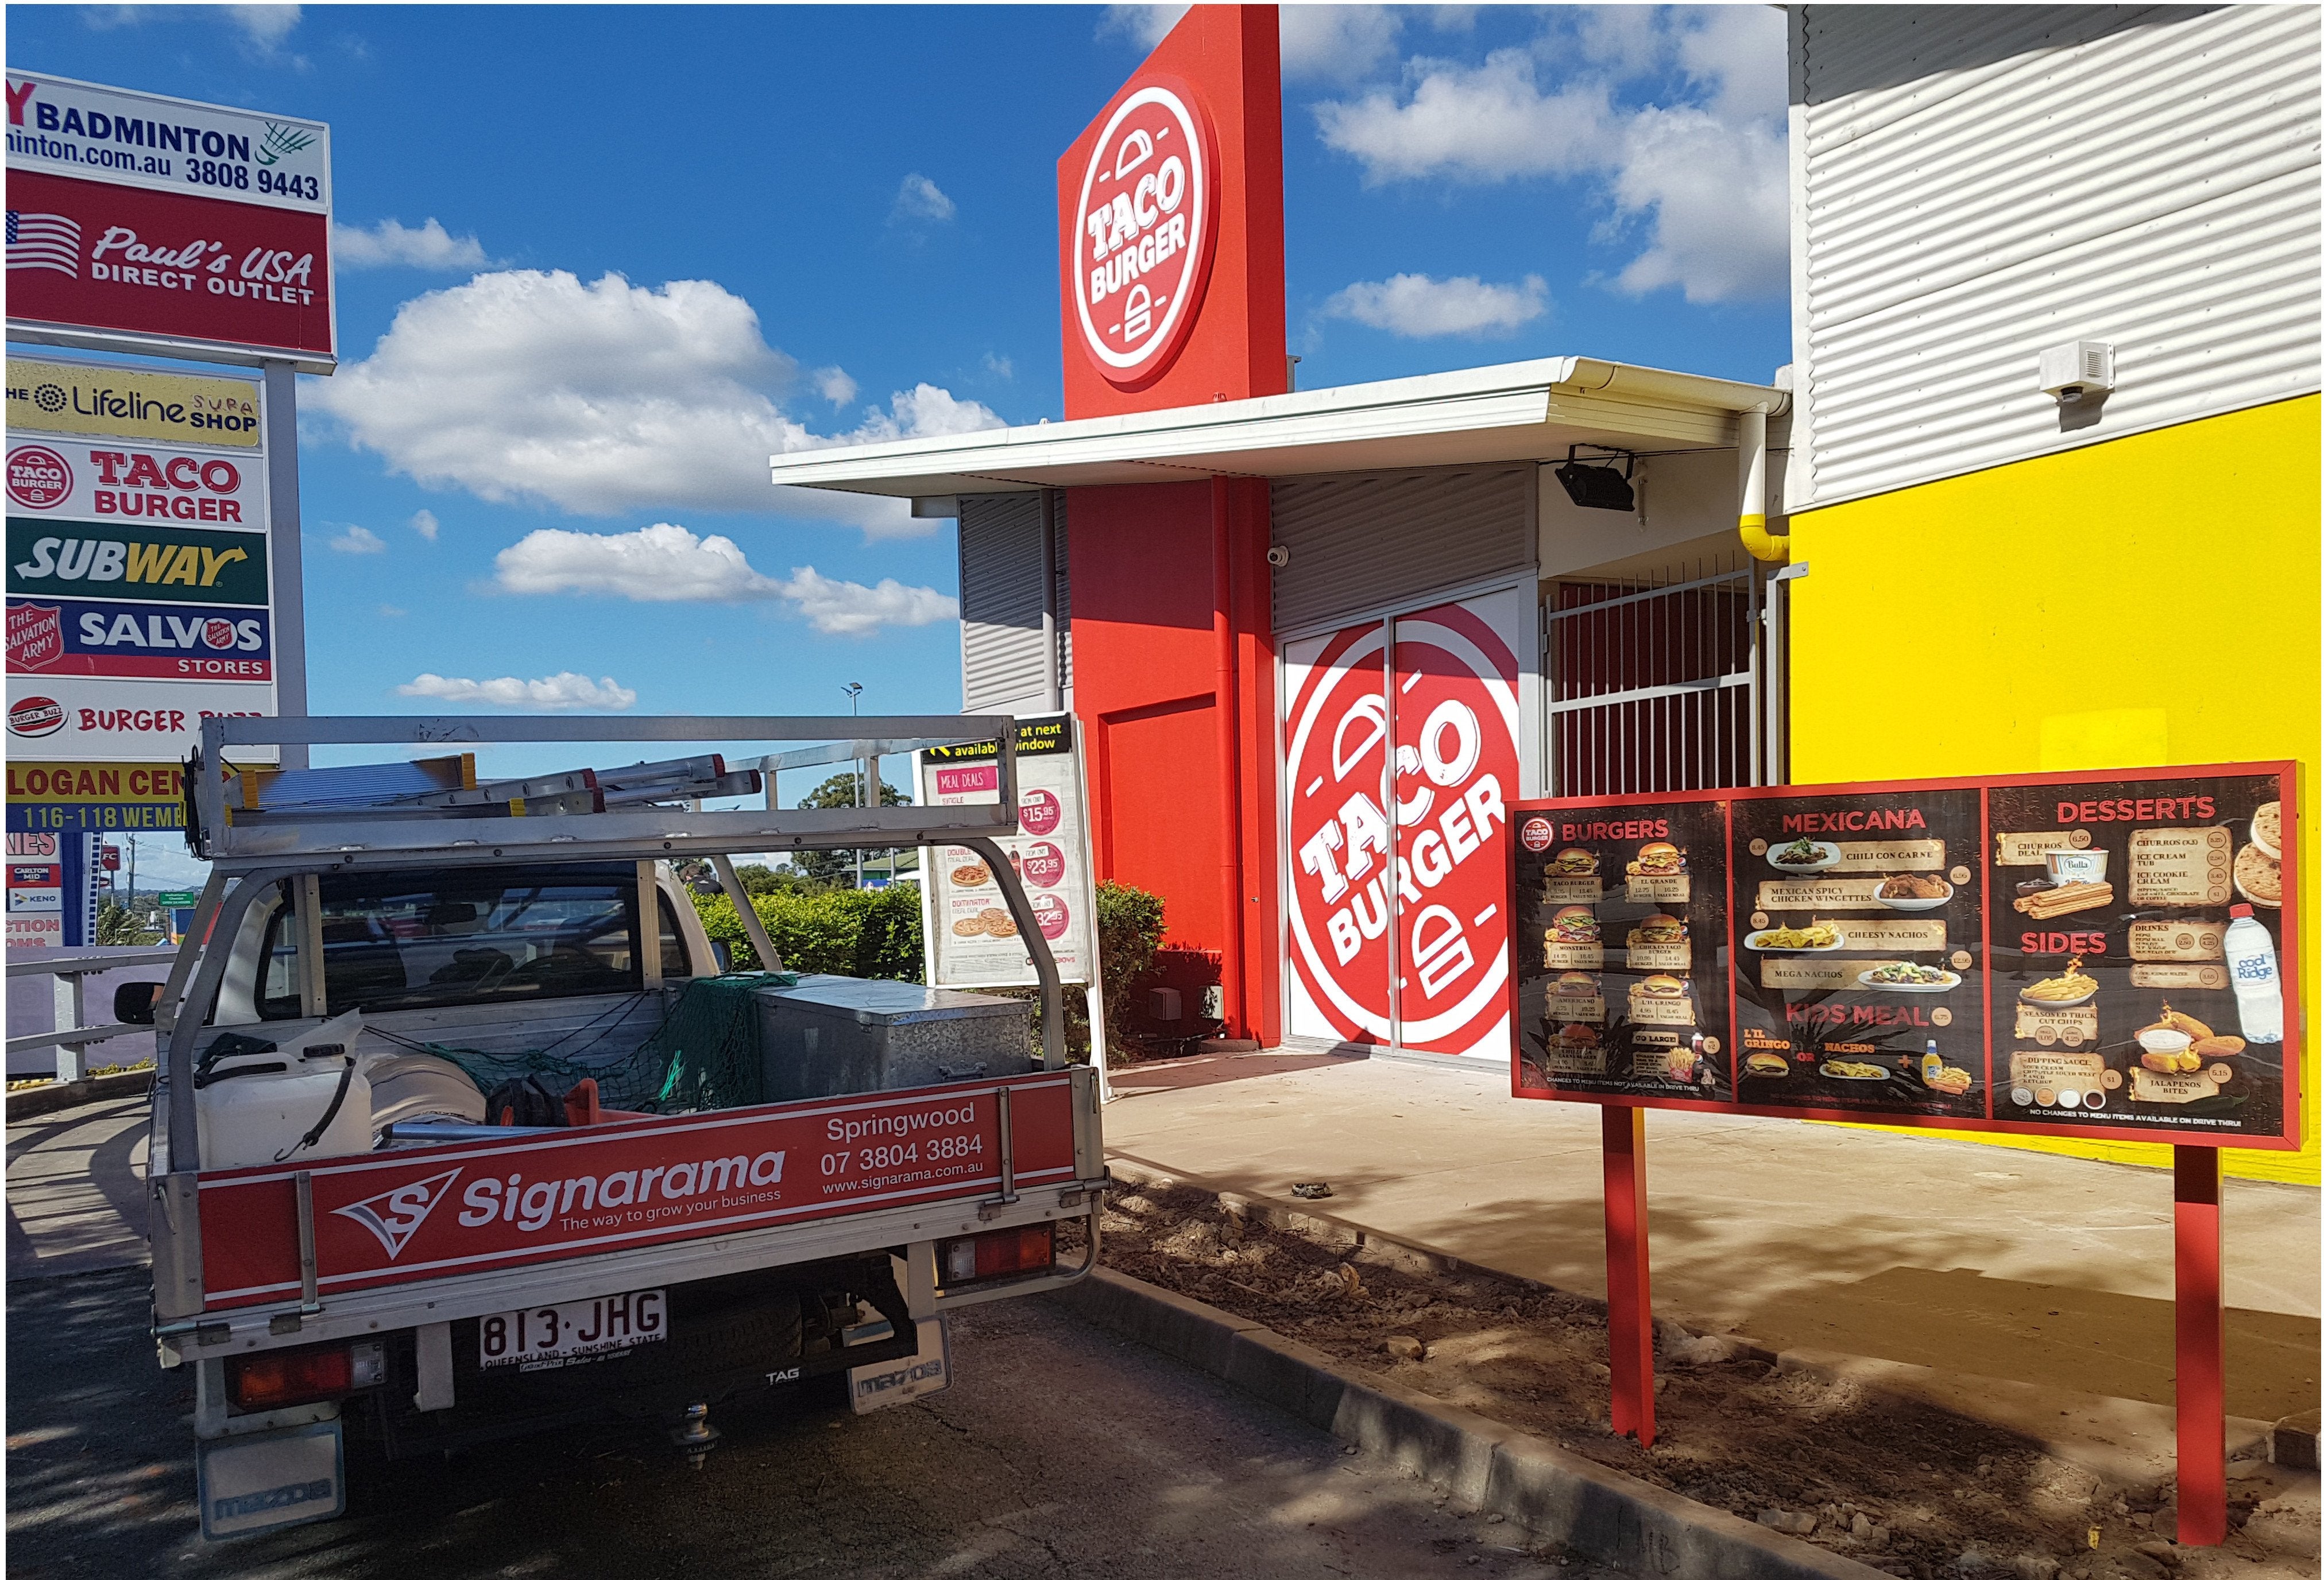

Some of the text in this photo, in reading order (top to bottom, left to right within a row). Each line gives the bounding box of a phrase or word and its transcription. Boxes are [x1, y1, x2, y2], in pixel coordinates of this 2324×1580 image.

[6, 79, 249, 162] Y BADMINTON
[185, 158, 249, 190] 3808
[258, 169, 319, 200] 9443
[1088, 155, 1185, 261] TACO
[91, 226, 314, 286] Paul's USA
[1091, 213, 1186, 304] BURGER
[92, 262, 314, 306] DIRECT OUTLET
[73, 386, 187, 423] Lifeline
[190, 412, 257, 431] SHOP
[11, 466, 61, 480] TACO
[12, 478, 63, 490] BURGER
[90, 451, 241, 494] TACO
[94, 490, 243, 522] BURGER
[14, 537, 248, 587] SUBWAY
[9, 609, 33, 630] THE
[211, 624, 221, 632] THE
[79, 612, 262, 651] SALVOS
[208, 626, 230, 641] SALVATION
[216, 633, 229, 645] ARMY
[21, 633, 54, 661] ARMY
[178, 660, 263, 675] STORES
[9, 707, 63, 723] BURGER BUZZ
[78, 708, 185, 733] BURGER
[1020, 724, 1062, 737] at next
[955, 742, 998, 757] availabl
[7, 769, 120, 795] LOGAN
[941, 772, 984, 788] MEAL DEALS
[1300, 699, 1482, 904] TACO
[2057, 796, 2215, 823] DESSERTS
[24, 807, 117, 827] 116-118
[1782, 808, 1927, 833] MEXICANA
[1525, 828, 1548, 836] TACO
[1562, 819, 1669, 842] BURGERS
[1326, 773, 1506, 967] BURGER
[2067, 861, 2089, 869] Bulla
[2021, 932, 2106, 953] SIDES
[2238, 954, 2266, 967] cool
[1775, 970, 1803, 978] MEGA
[2237, 967, 2272, 979] Ridge
[1786, 1003, 1929, 1027] KIDS MEAL
[1744, 1039, 1791, 1050] GRINGO
[1824, 1043, 1875, 1053] NACHOS
[1797, 1052, 1815, 1062] OR
[2151, 1080, 2201, 1088] JALAPENOS
[827, 1102, 975, 1144] Springwood
[821, 1133, 983, 1176] 07 3804 3884
[822, 1162, 983, 1194] www.signarama.com.au
[459, 1151, 786, 1232] Signarama
[560, 1189, 781, 1232] The way to grow your business
[485, 1349, 559, 1368] QUEENSLAND
[571, 1339, 622, 1356] SUNSHINE
[629, 1333, 662, 1346] STATE
[765, 1366, 801, 1385] TAG
